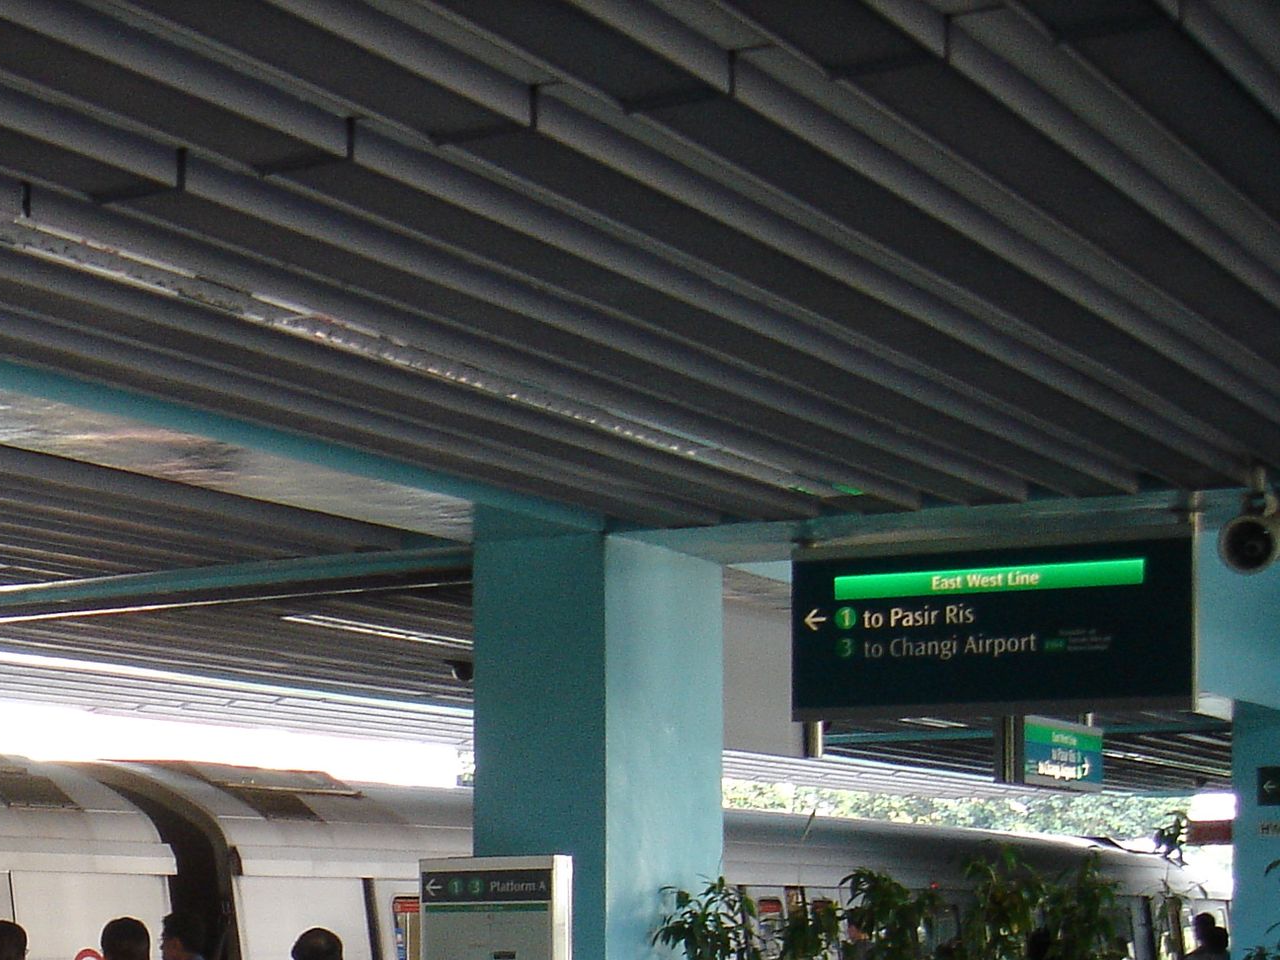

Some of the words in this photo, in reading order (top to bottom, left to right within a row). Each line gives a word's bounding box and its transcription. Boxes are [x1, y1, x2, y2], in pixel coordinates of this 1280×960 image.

[931, 576, 962, 591] East
[966, 573, 1003, 588] West
[1007, 570, 1040, 586] Line
[863, 610, 884, 629] to
[889, 605, 940, 627] Pasir
[945, 603, 975, 624] Ris
[840, 639, 853, 658] 3
[863, 641, 883, 658] to
[889, 634, 958, 660] Changi
[964, 632, 1037, 658] Airport
[489, 880, 536, 892] Platform
[539, 881, 547, 891] A
